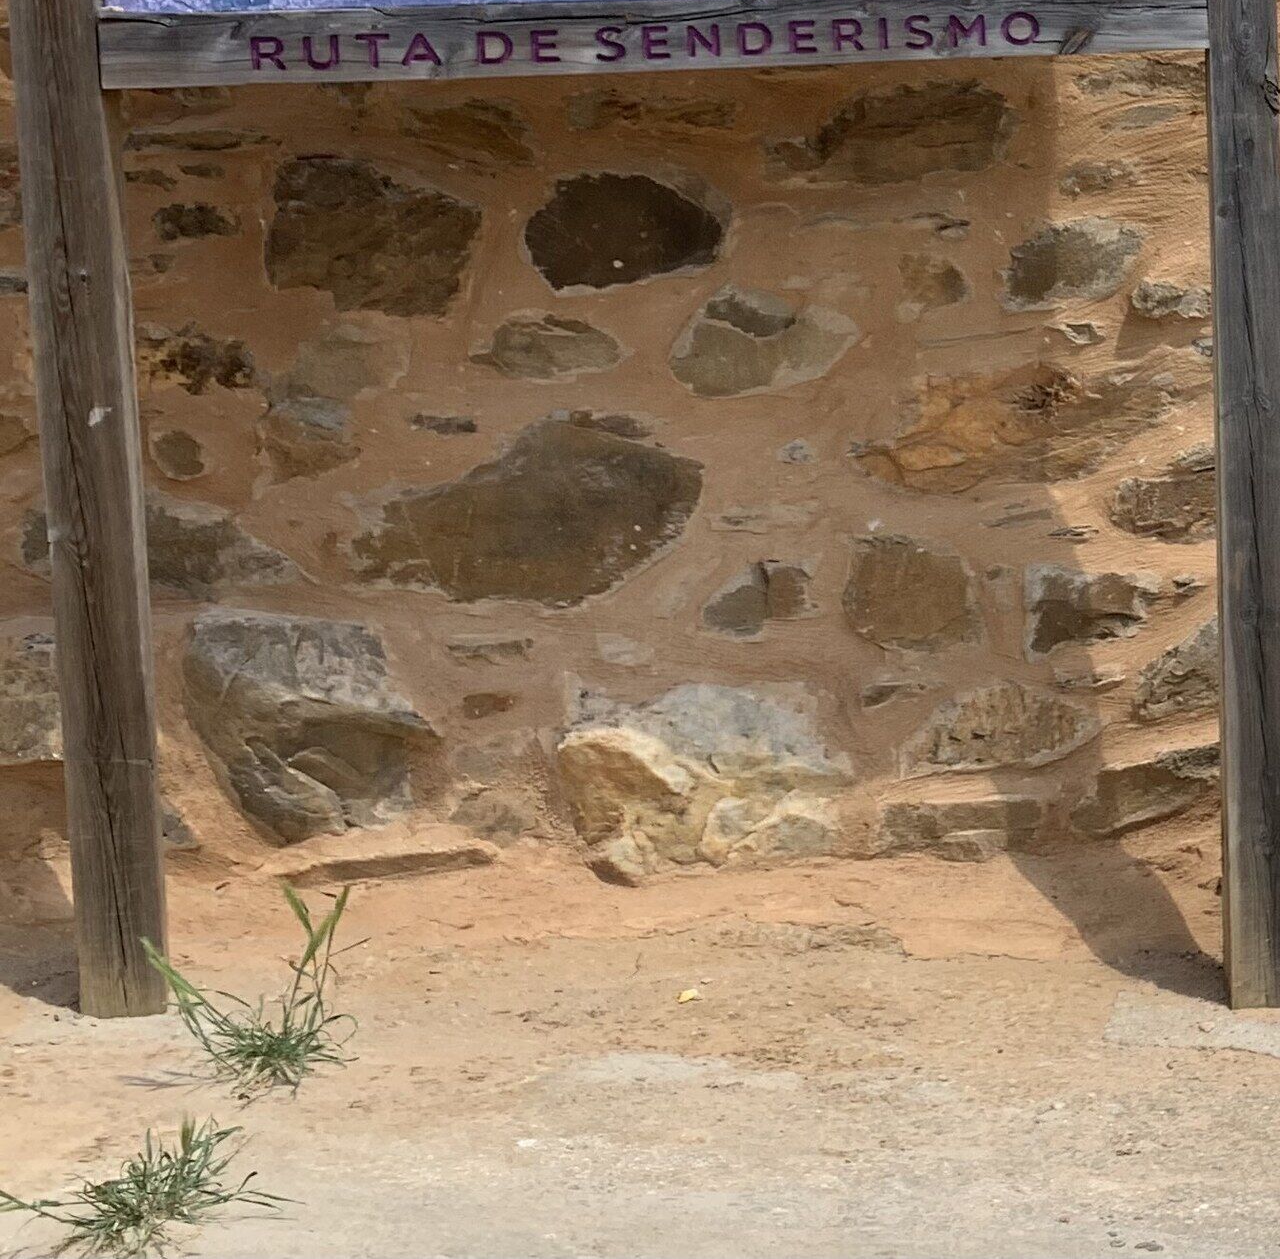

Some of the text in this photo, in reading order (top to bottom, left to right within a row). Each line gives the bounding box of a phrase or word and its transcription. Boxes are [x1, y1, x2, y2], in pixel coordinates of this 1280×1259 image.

[250, 10, 1041, 71] RUTA DE SENDERISMO
